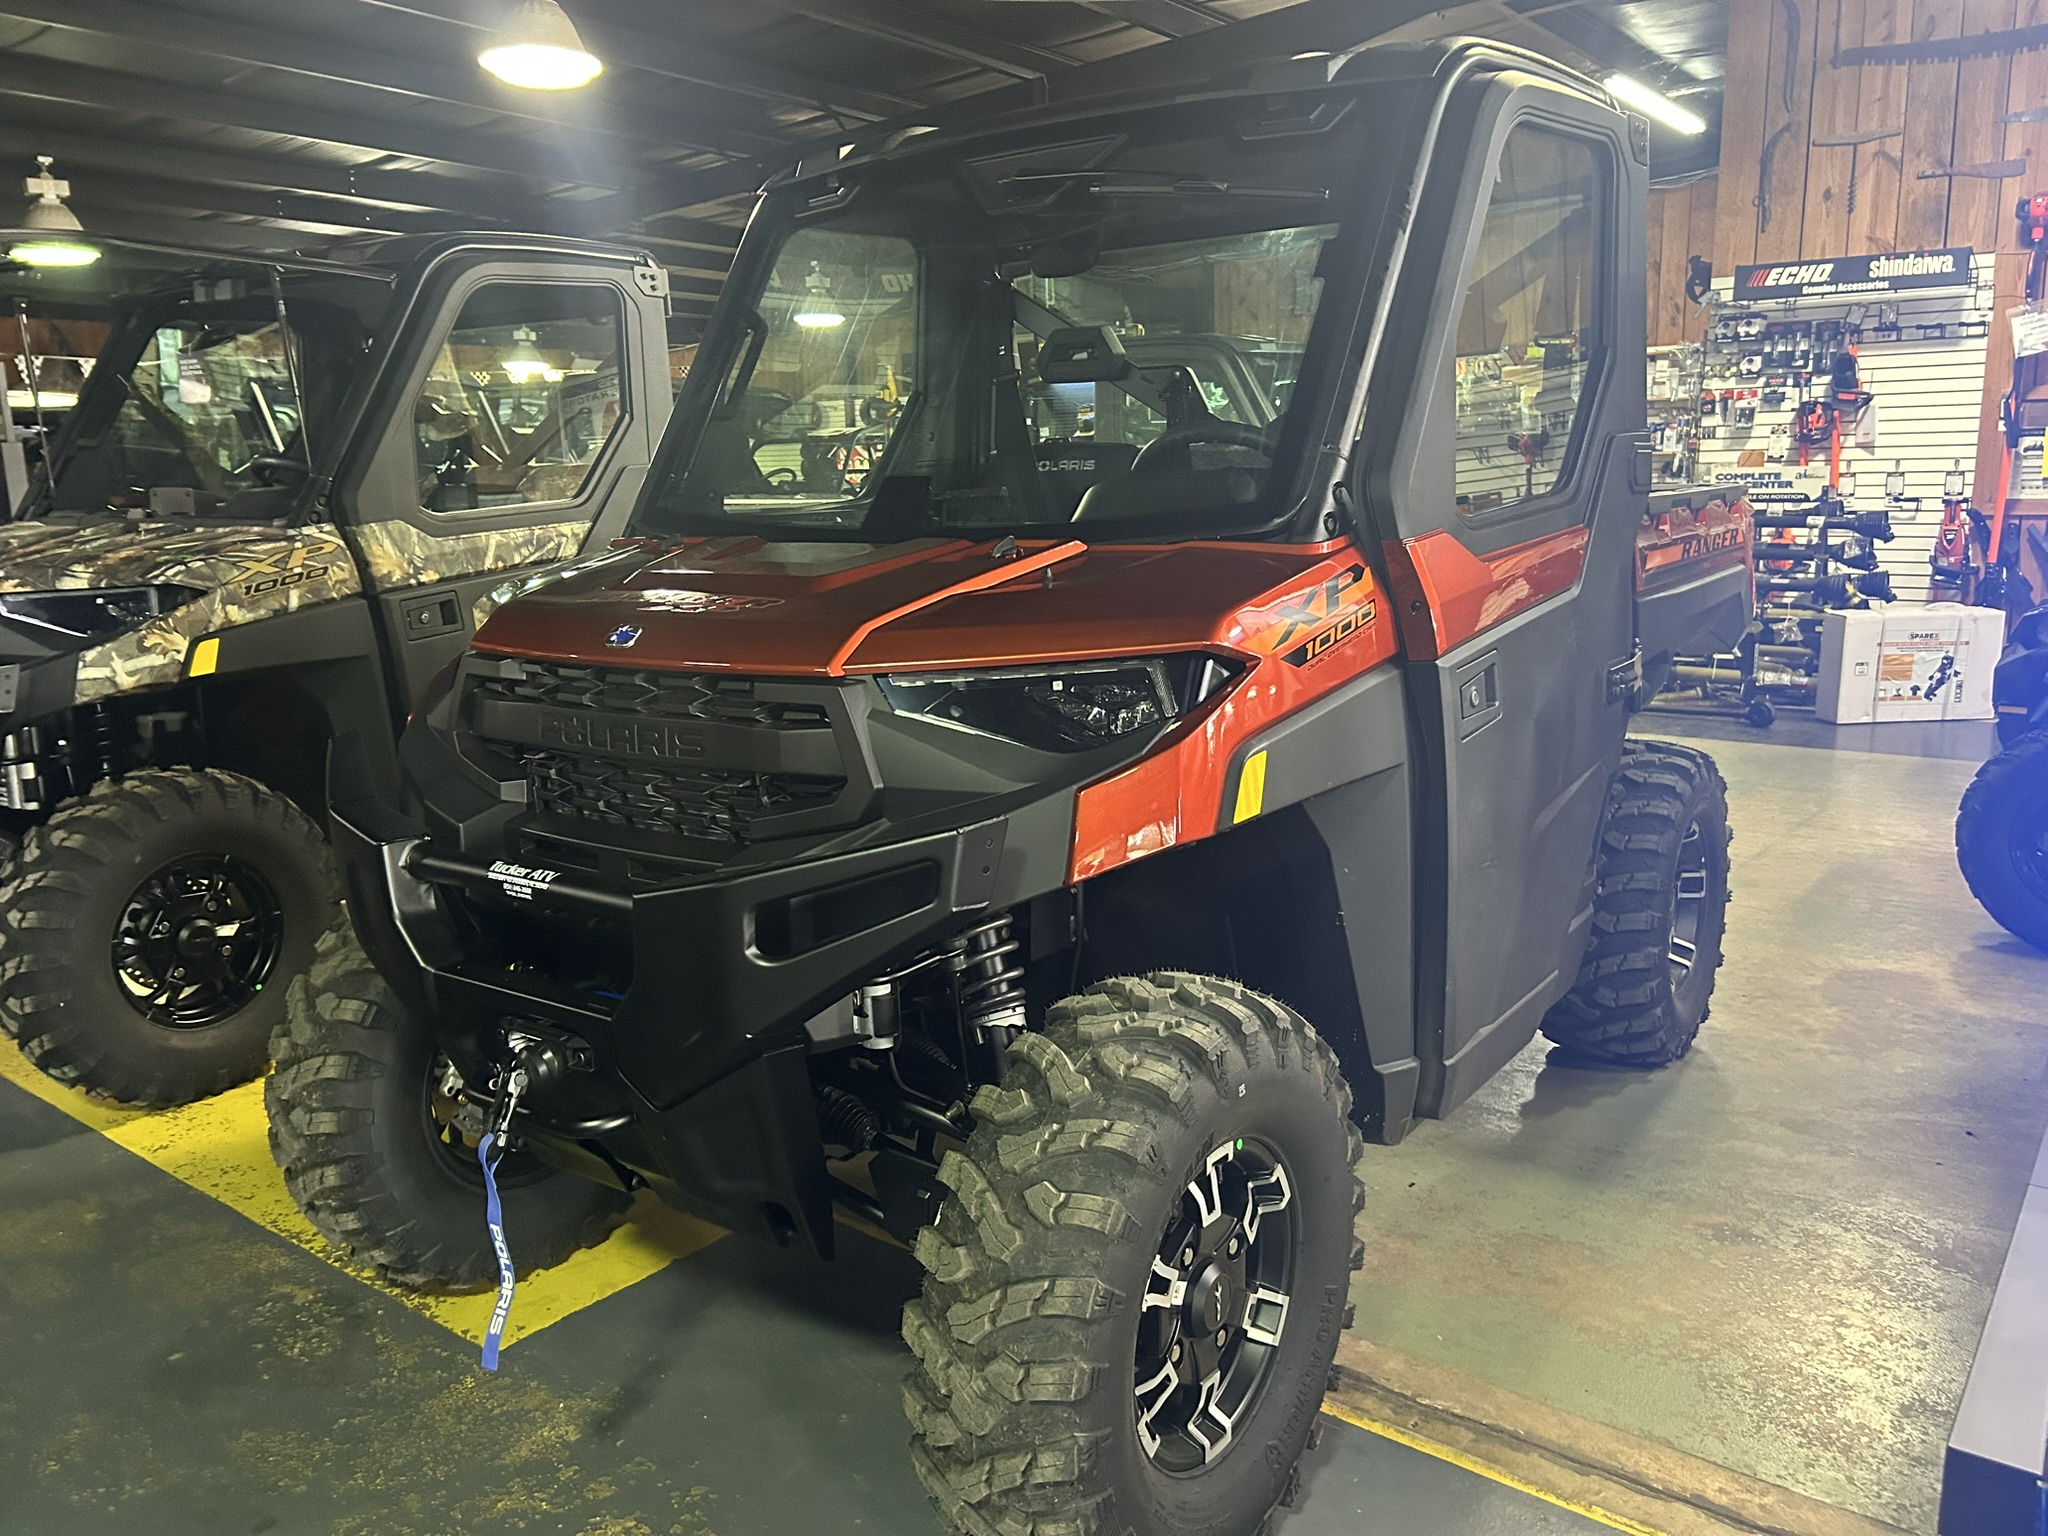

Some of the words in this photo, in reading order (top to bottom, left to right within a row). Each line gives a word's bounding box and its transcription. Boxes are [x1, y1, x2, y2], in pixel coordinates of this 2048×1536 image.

[1764, 263, 1834, 287] ECHO
[1869, 252, 1955, 279] shindaiwa
[1802, 284, 1837, 295] Genuine
[1837, 280, 1889, 292] Accessories
[1038, 459, 1096, 472] OLARIS
[1715, 472, 1782, 480] COMPLETE
[1681, 528, 1739, 560] RANGER
[226, 541, 339, 585] XP
[244, 566, 329, 597] 1000
[1271, 563, 1365, 651] XP
[1305, 600, 1376, 660] 1000
[538, 711, 704, 760] POLARIS
[489, 861, 532, 877] Tucker
[528, 869, 561, 882] ATV
[489, 1223, 513, 1336] POLARIS
